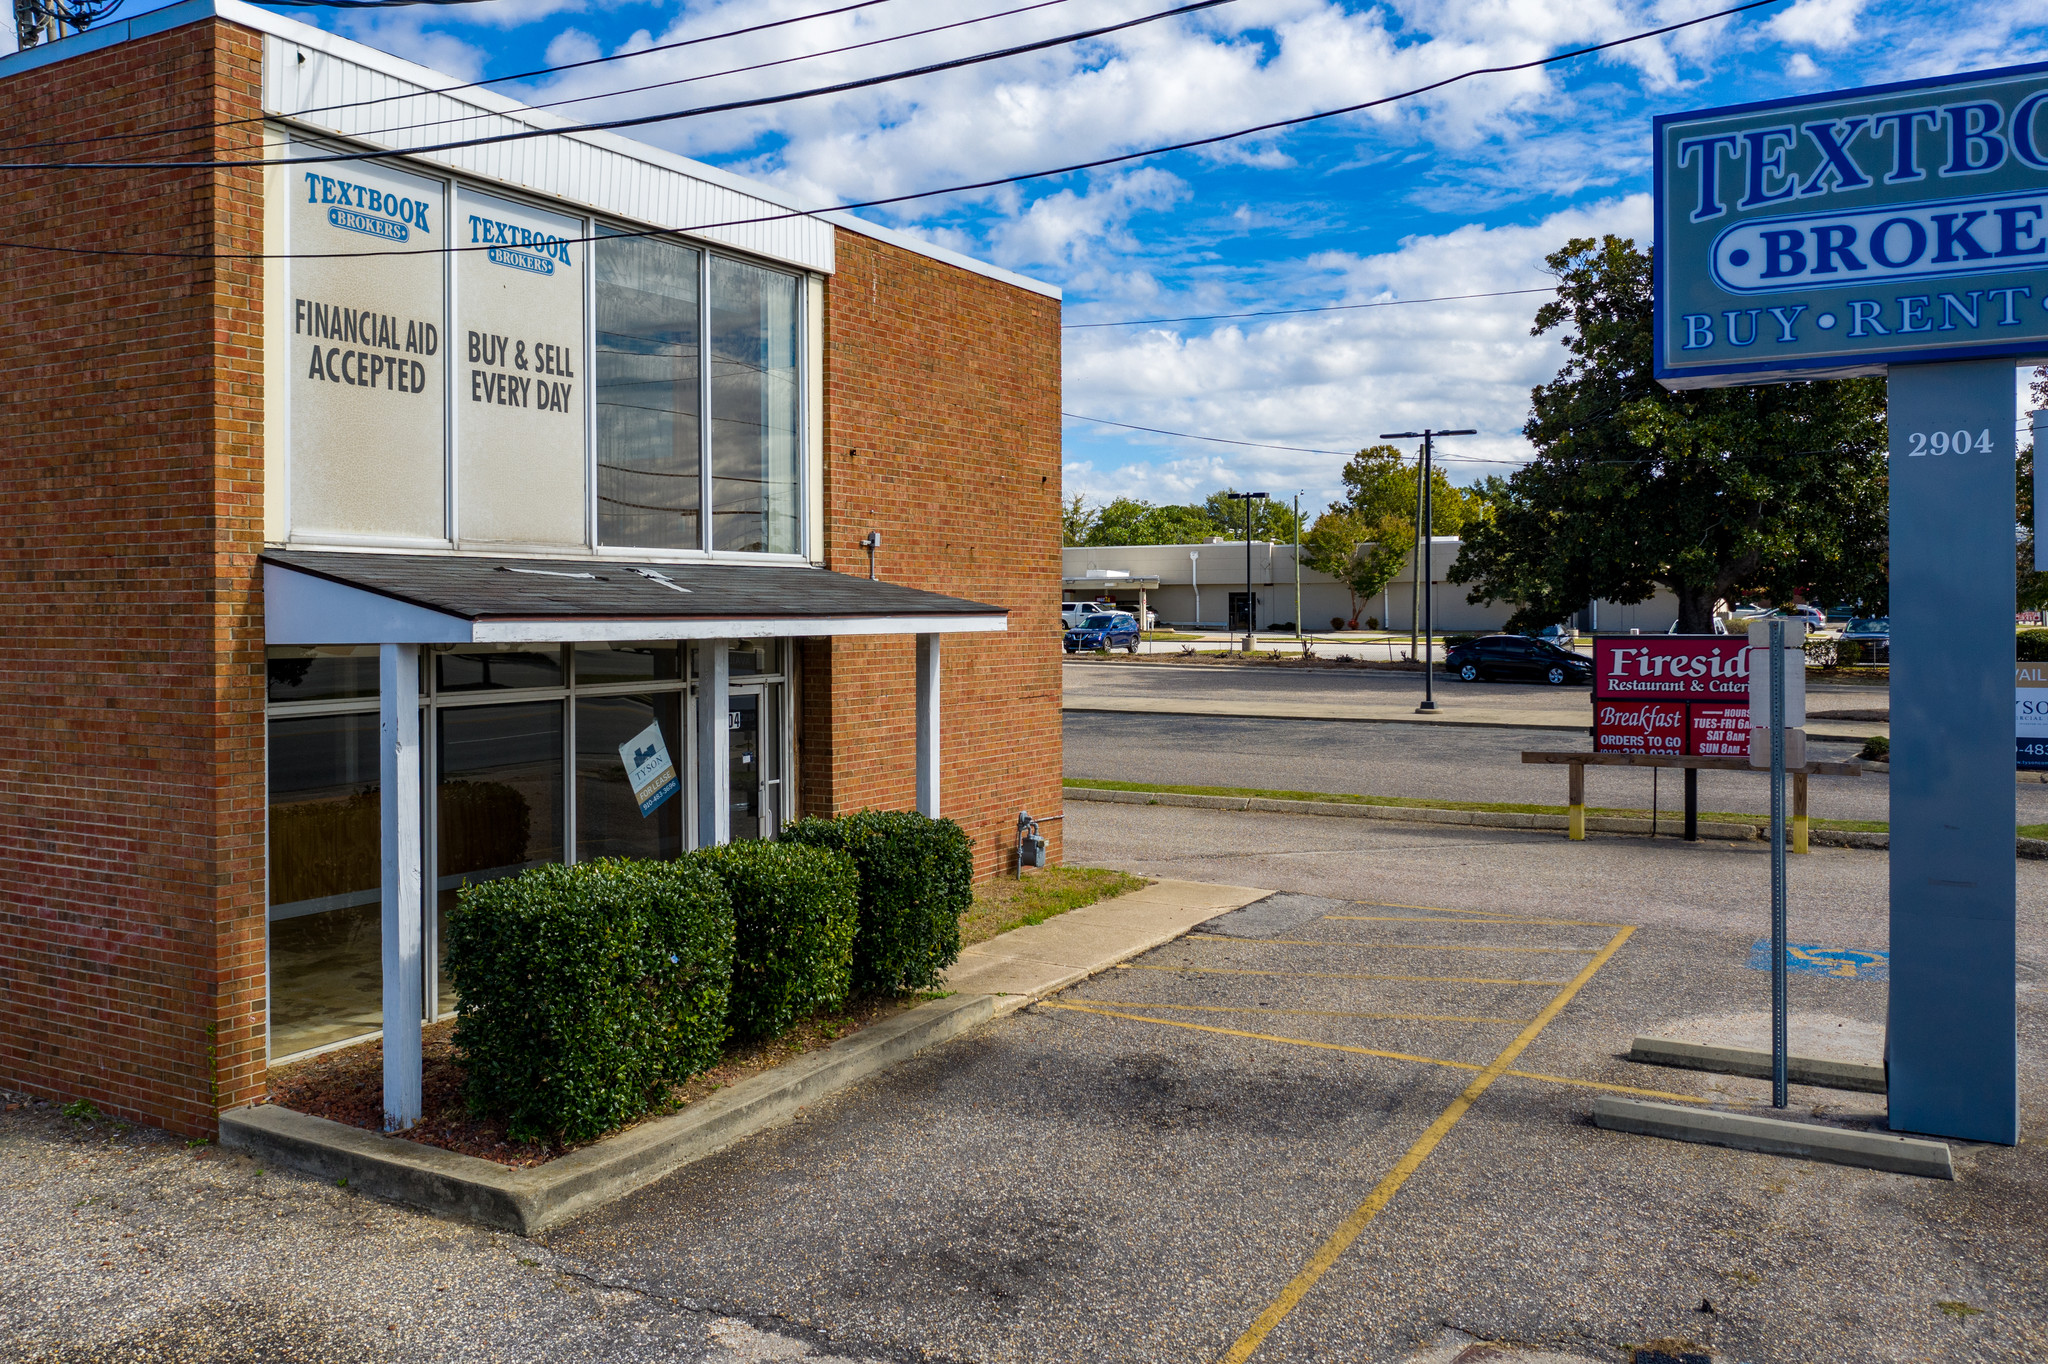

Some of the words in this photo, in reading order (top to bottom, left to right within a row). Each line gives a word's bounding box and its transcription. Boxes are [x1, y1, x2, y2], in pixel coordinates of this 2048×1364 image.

[305, 172, 430, 233] TEXTBOOK
[337, 210, 401, 238] BROKERS
[469, 215, 571, 267] TEXTBOOK
[1759, 205, 2047, 279] BROKE
[495, 250, 549, 273] BROKERS
[295, 298, 400, 350] FINANCIAL
[405, 319, 438, 356] AID
[1682, 304, 1808, 350] BUY
[1846, 286, 2031, 338] RENT
[468, 330, 508, 367] BUY
[515, 340, 529, 371] &
[535, 342, 574, 378] SELL
[308, 345, 426, 393] ACCEPTED
[471, 370, 531, 408] EVERY
[537, 380, 572, 413] DAY
[1908, 428, 1995, 457] 2904
[1608, 679, 1686, 691] Restaurant
[1690, 679, 1705, 692] &
[1600, 705, 1682, 735] Breakfast
[1694, 718, 1736, 729] TUES-FRI
[1600, 734, 1645, 746] ORDERS
[1647, 736, 1662, 747] TO
[1665, 737, 1682, 748] GO
[1699, 743, 1719, 753] SUN
[1721, 743, 1740, 754] 8AM
[1706, 730, 1725, 741] SAT
[1726, 731, 1745, 742] 8AM
[635, 755, 663, 780] TYSON
[640, 786, 653, 800] FOR
[652, 771, 671, 790] LEASE
[643, 781, 676, 810] 910-483-3696
